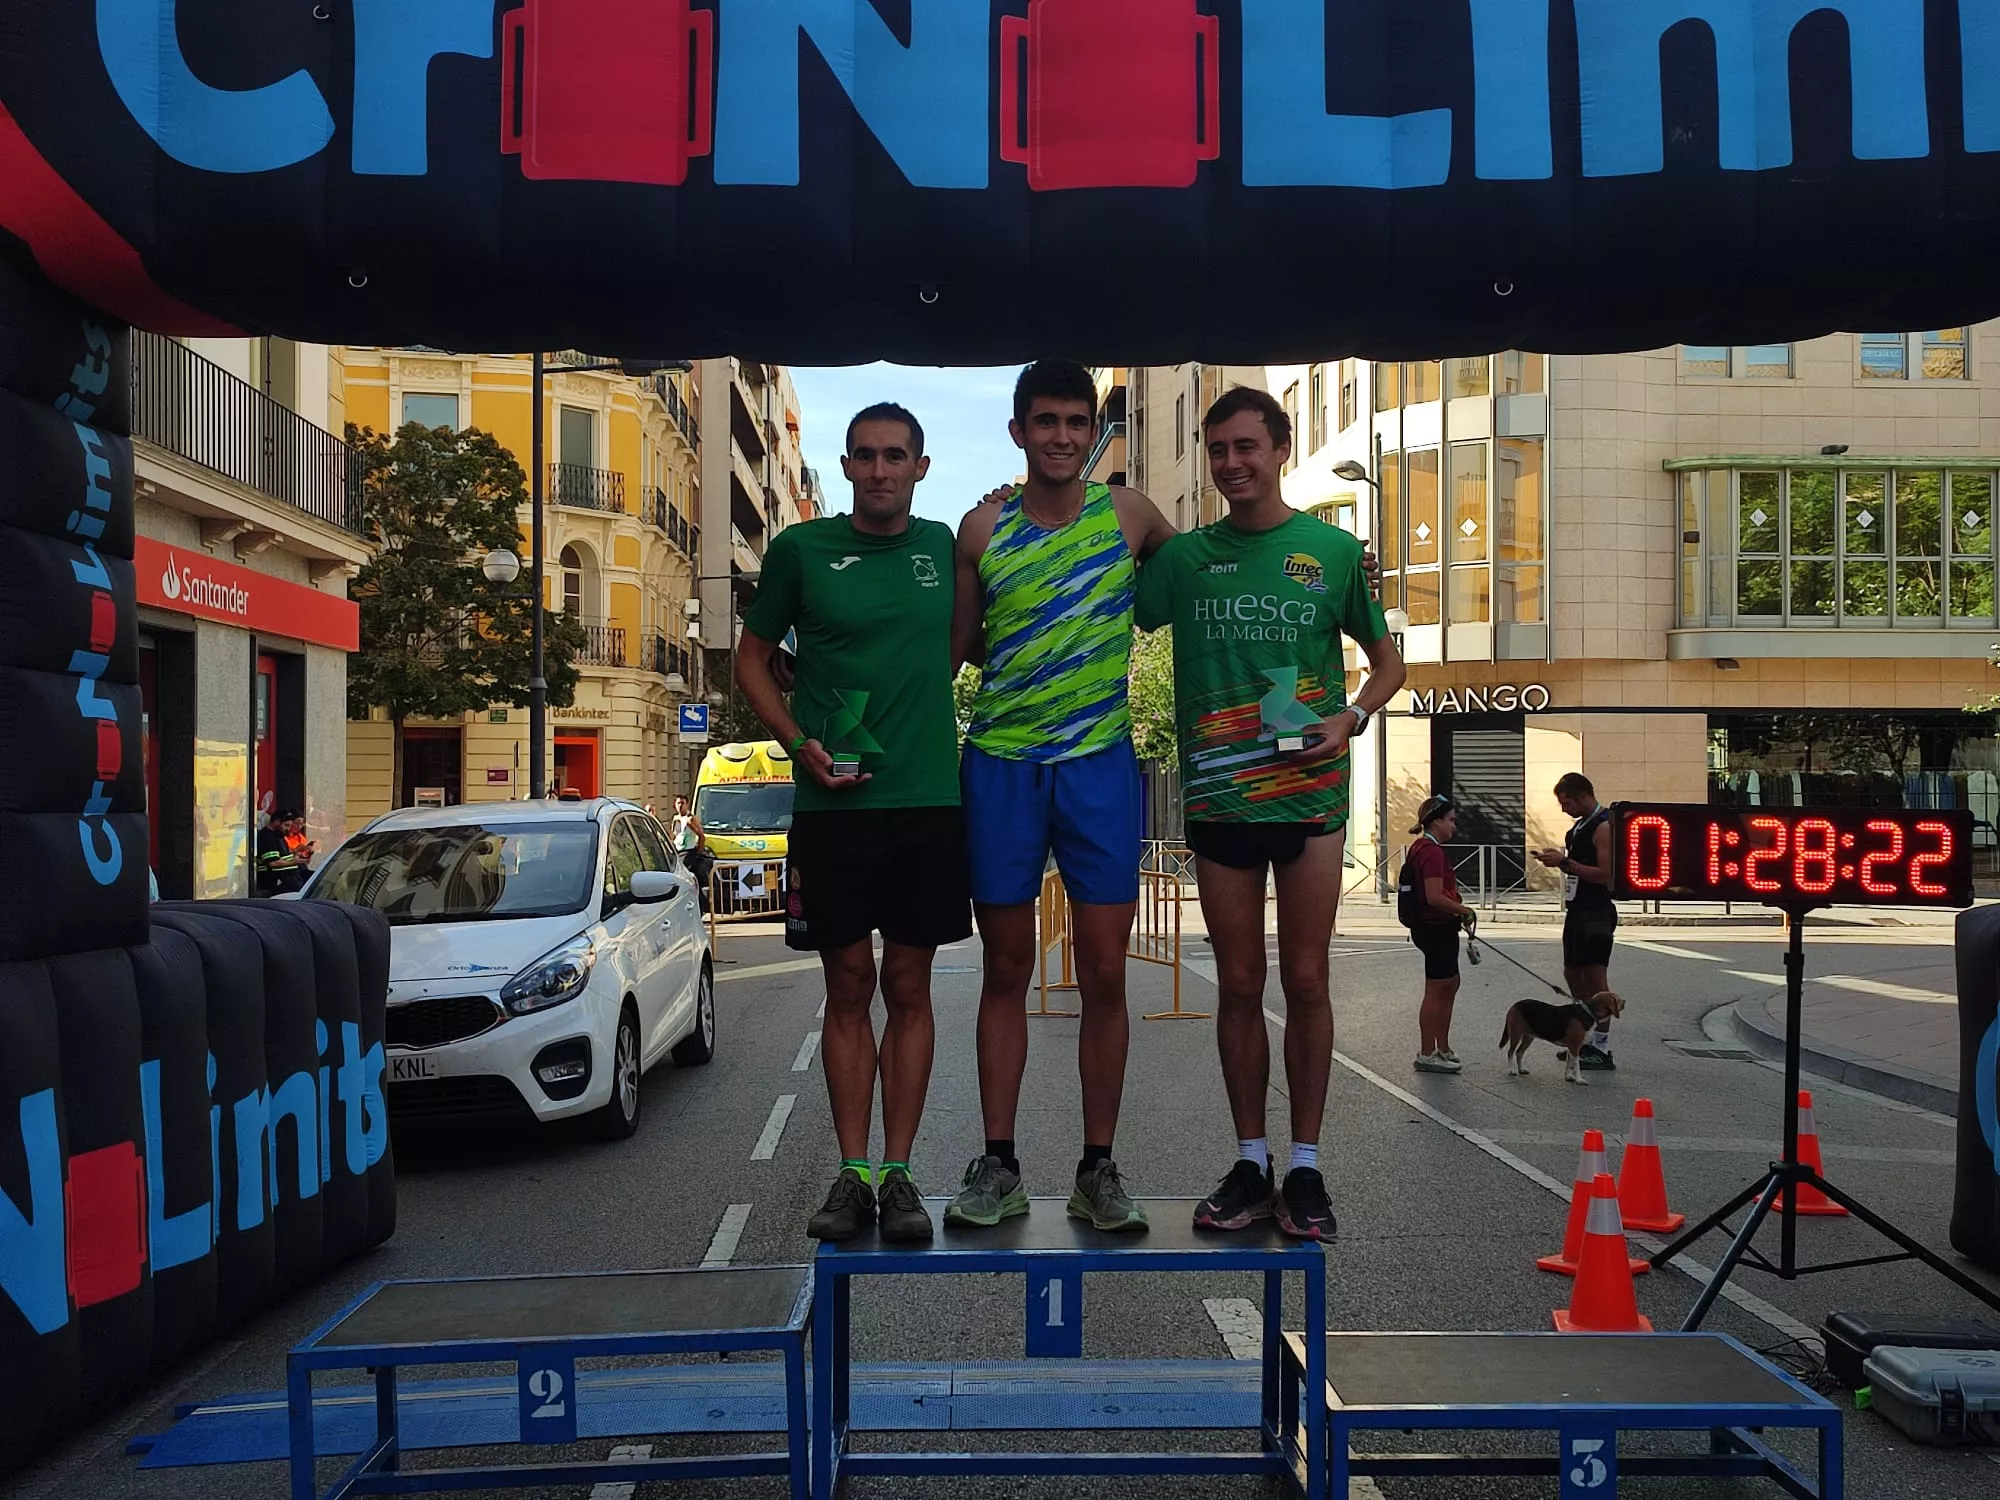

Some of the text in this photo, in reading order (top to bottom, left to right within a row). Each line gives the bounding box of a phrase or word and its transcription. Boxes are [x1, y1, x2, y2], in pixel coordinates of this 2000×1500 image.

[182, 567, 249, 615] Santander
[1409, 685, 1550, 714] MANGO
[393, 1057, 434, 1079] KNL
[1040, 1278, 1065, 1327] 1
[528, 1369, 565, 1418] 2
[1570, 1438, 1607, 1489] 3
